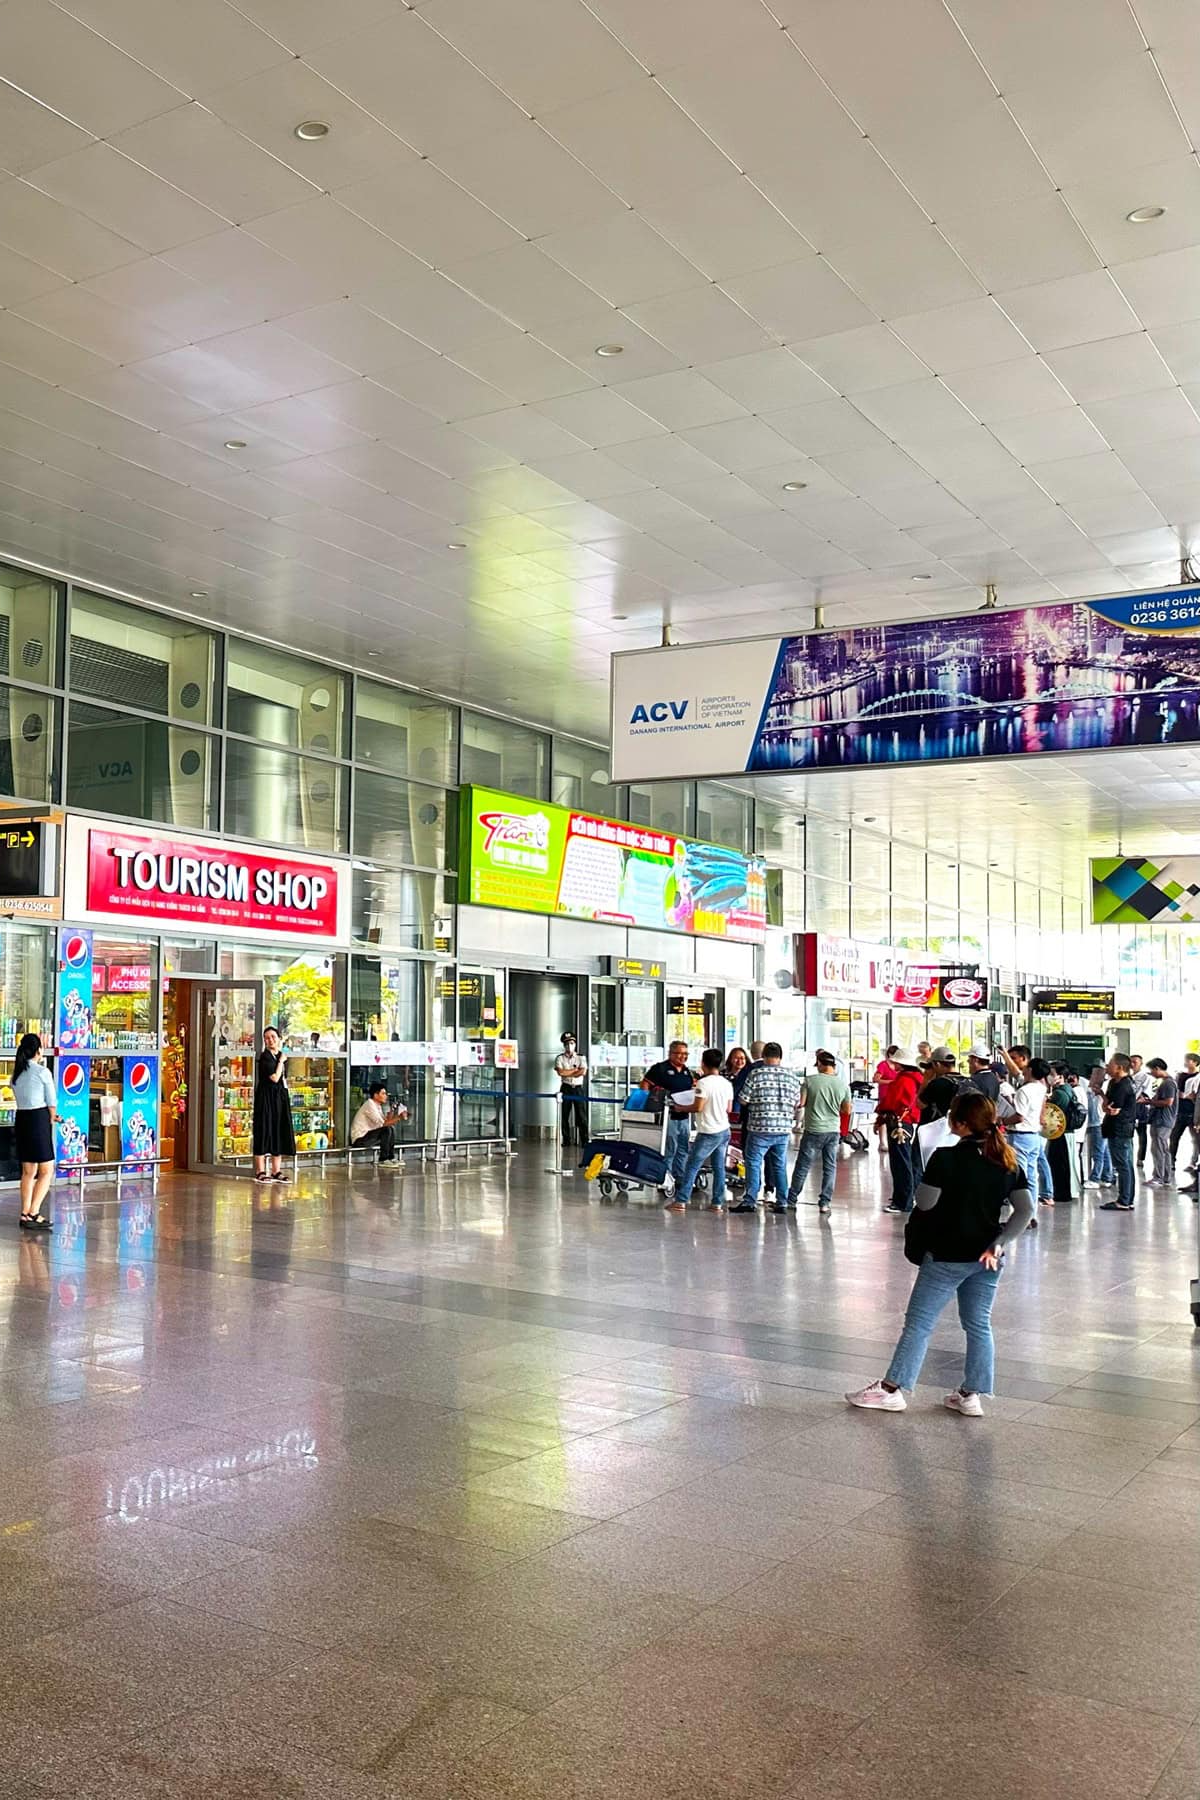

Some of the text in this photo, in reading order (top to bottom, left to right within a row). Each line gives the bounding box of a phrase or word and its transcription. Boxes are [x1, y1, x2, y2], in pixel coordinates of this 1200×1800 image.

[1133, 601, 1155, 611] LIÊN
[1156, 598, 1170, 608] HỆ
[1130, 606, 1200, 625] 0236 3614
[701, 696, 736, 704] AIRPORTS
[701, 702, 751, 711] CORPORATION
[630, 700, 688, 724] ACV
[712, 709, 742, 717] VIETNAM
[630, 720, 745, 735] DANANG INTERNATIONAL AIRPORT
[112, 847, 328, 911] TOURISM SHOP
